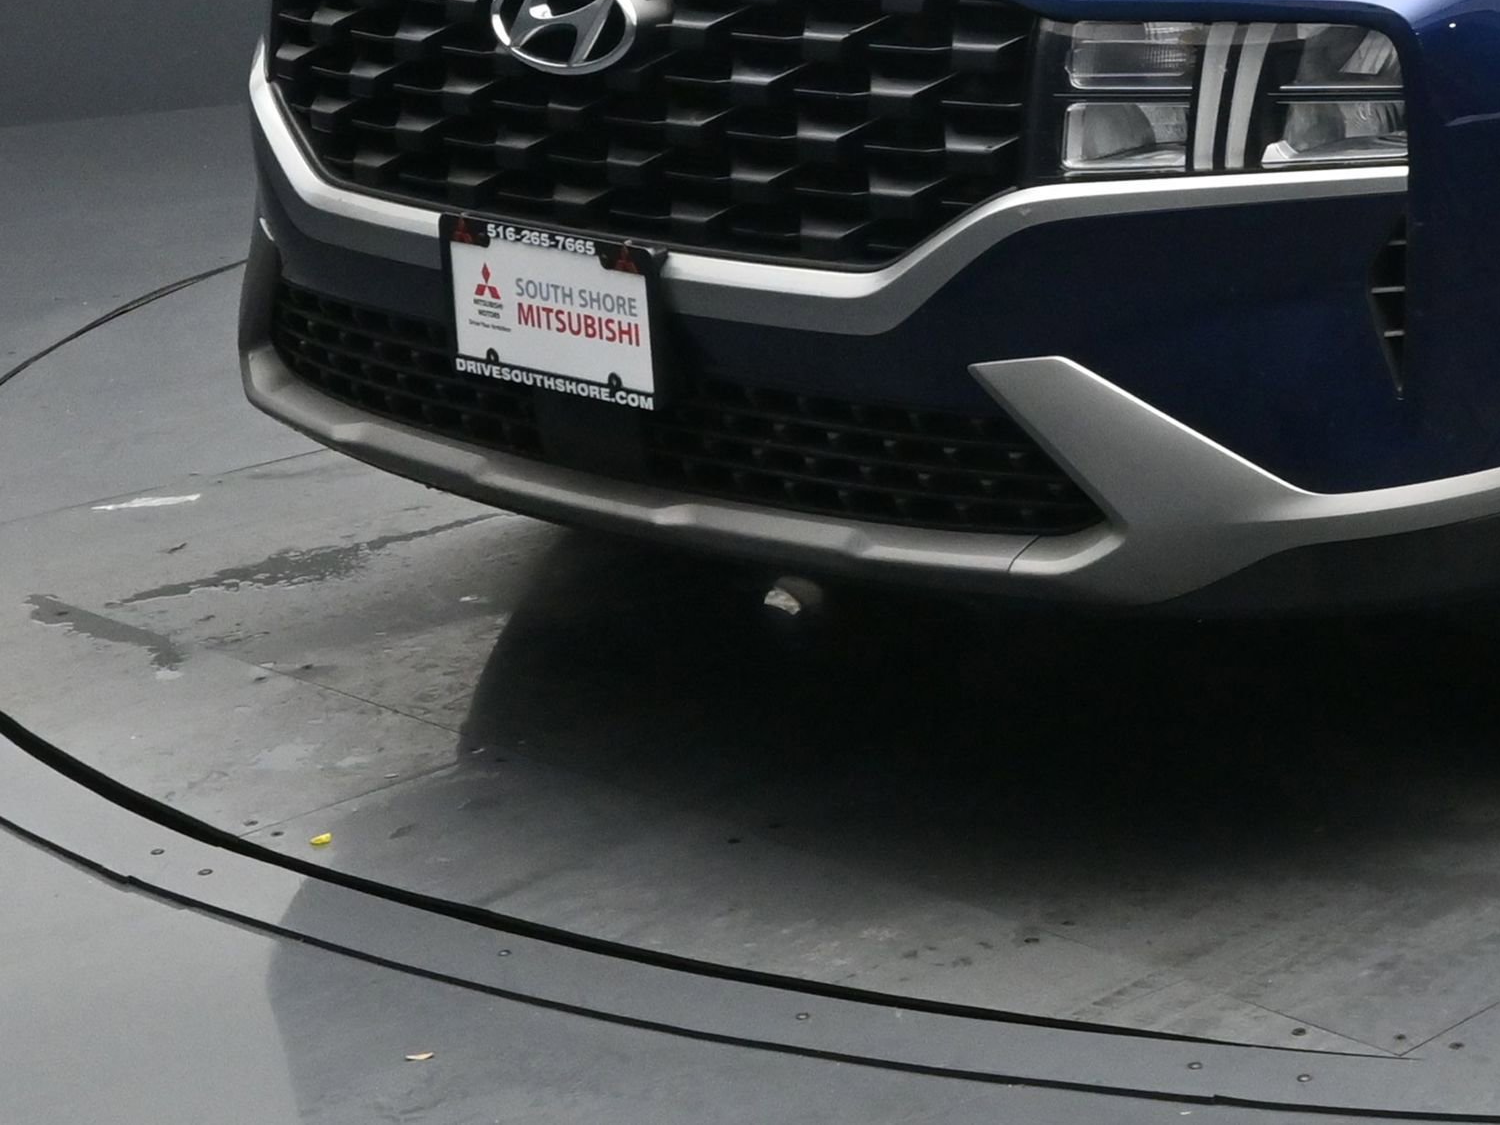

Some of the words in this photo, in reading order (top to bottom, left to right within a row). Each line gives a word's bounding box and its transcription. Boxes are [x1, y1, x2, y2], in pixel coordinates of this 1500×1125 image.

[486, 223, 596, 255] 516-265-7665
[515, 277, 574, 306] SOUTH
[579, 288, 638, 317] SHORE
[517, 302, 641, 347] MITSUBISHI
[455, 358, 654, 411] DRIVESOUTHSHORE.COM
